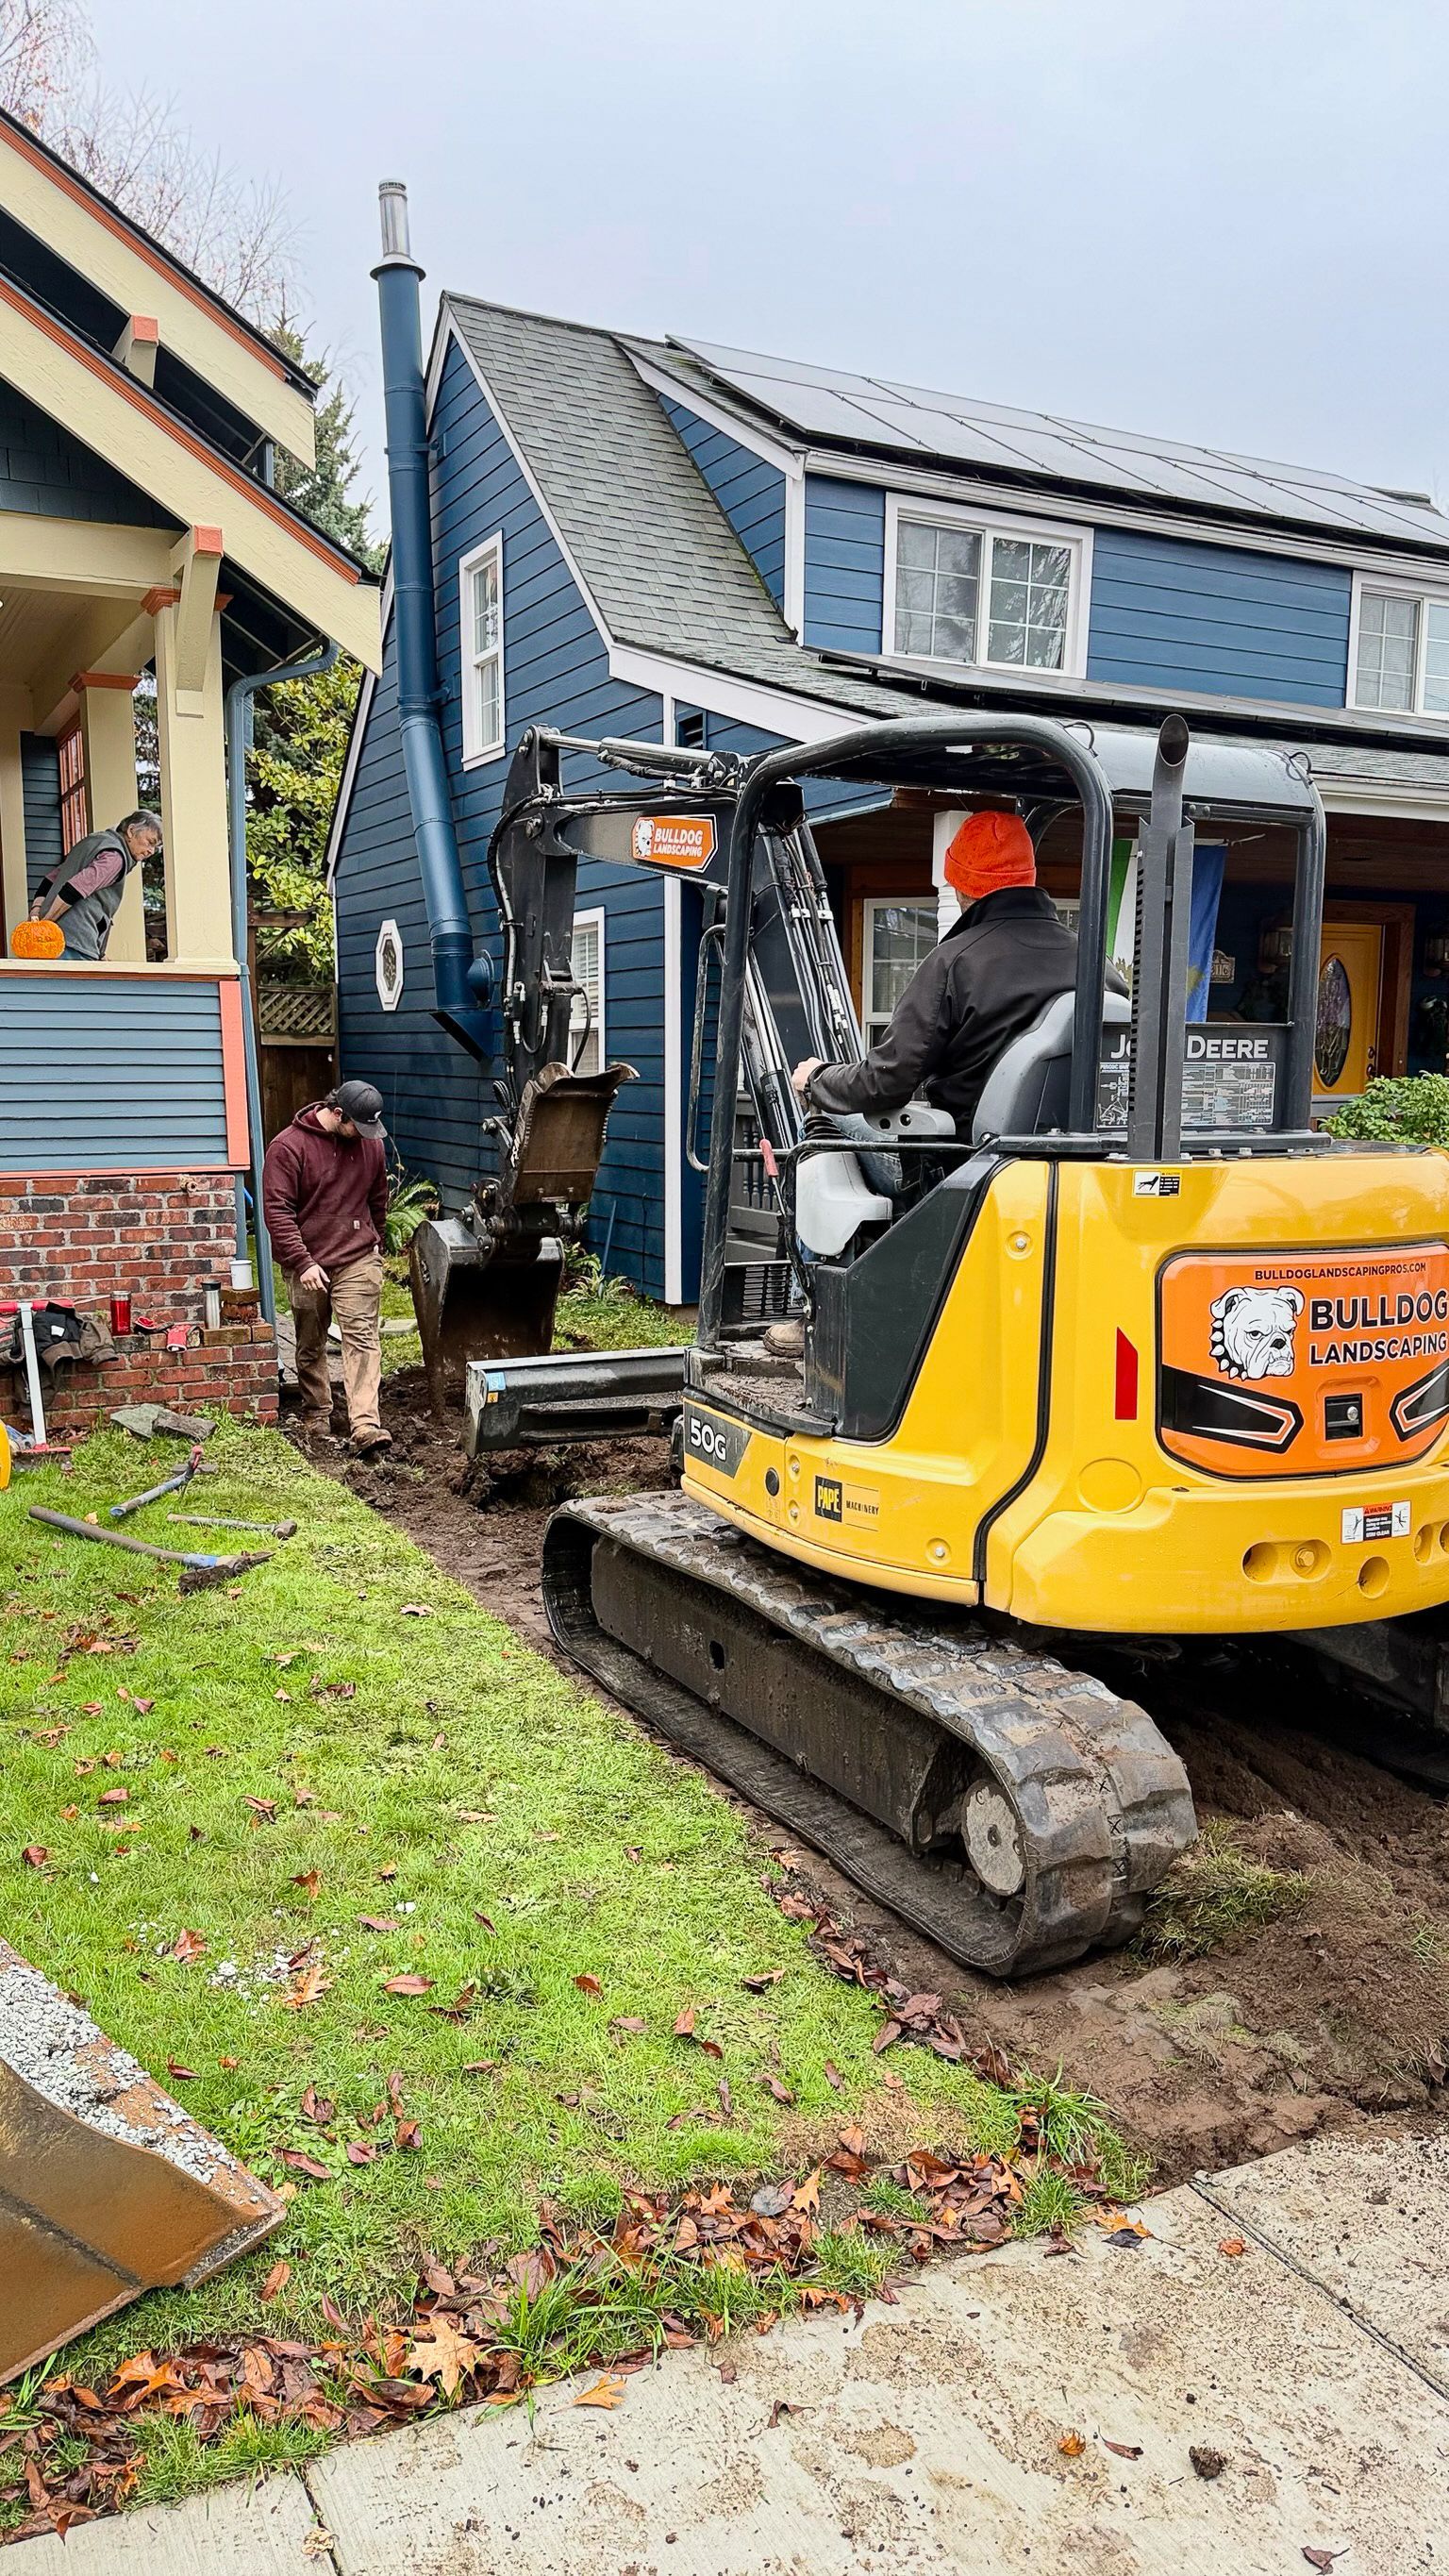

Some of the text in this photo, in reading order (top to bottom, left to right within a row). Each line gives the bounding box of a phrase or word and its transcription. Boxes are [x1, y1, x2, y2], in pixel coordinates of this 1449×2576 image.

[655, 828, 704, 845] BULLDOG
[653, 845, 703, 857] LANDSCAPING
[1187, 1034, 1269, 1059] DEERE
[1254, 1262, 1426, 1280] BULLDOGLANDSCAPINGPROS.COM
[1310, 1289, 1449, 1331] BULLDOG
[1310, 1331, 1447, 1365] LANDSCAPING
[690, 1415, 727, 1463] 50G
[845, 1499, 879, 1515] MACHINERY
